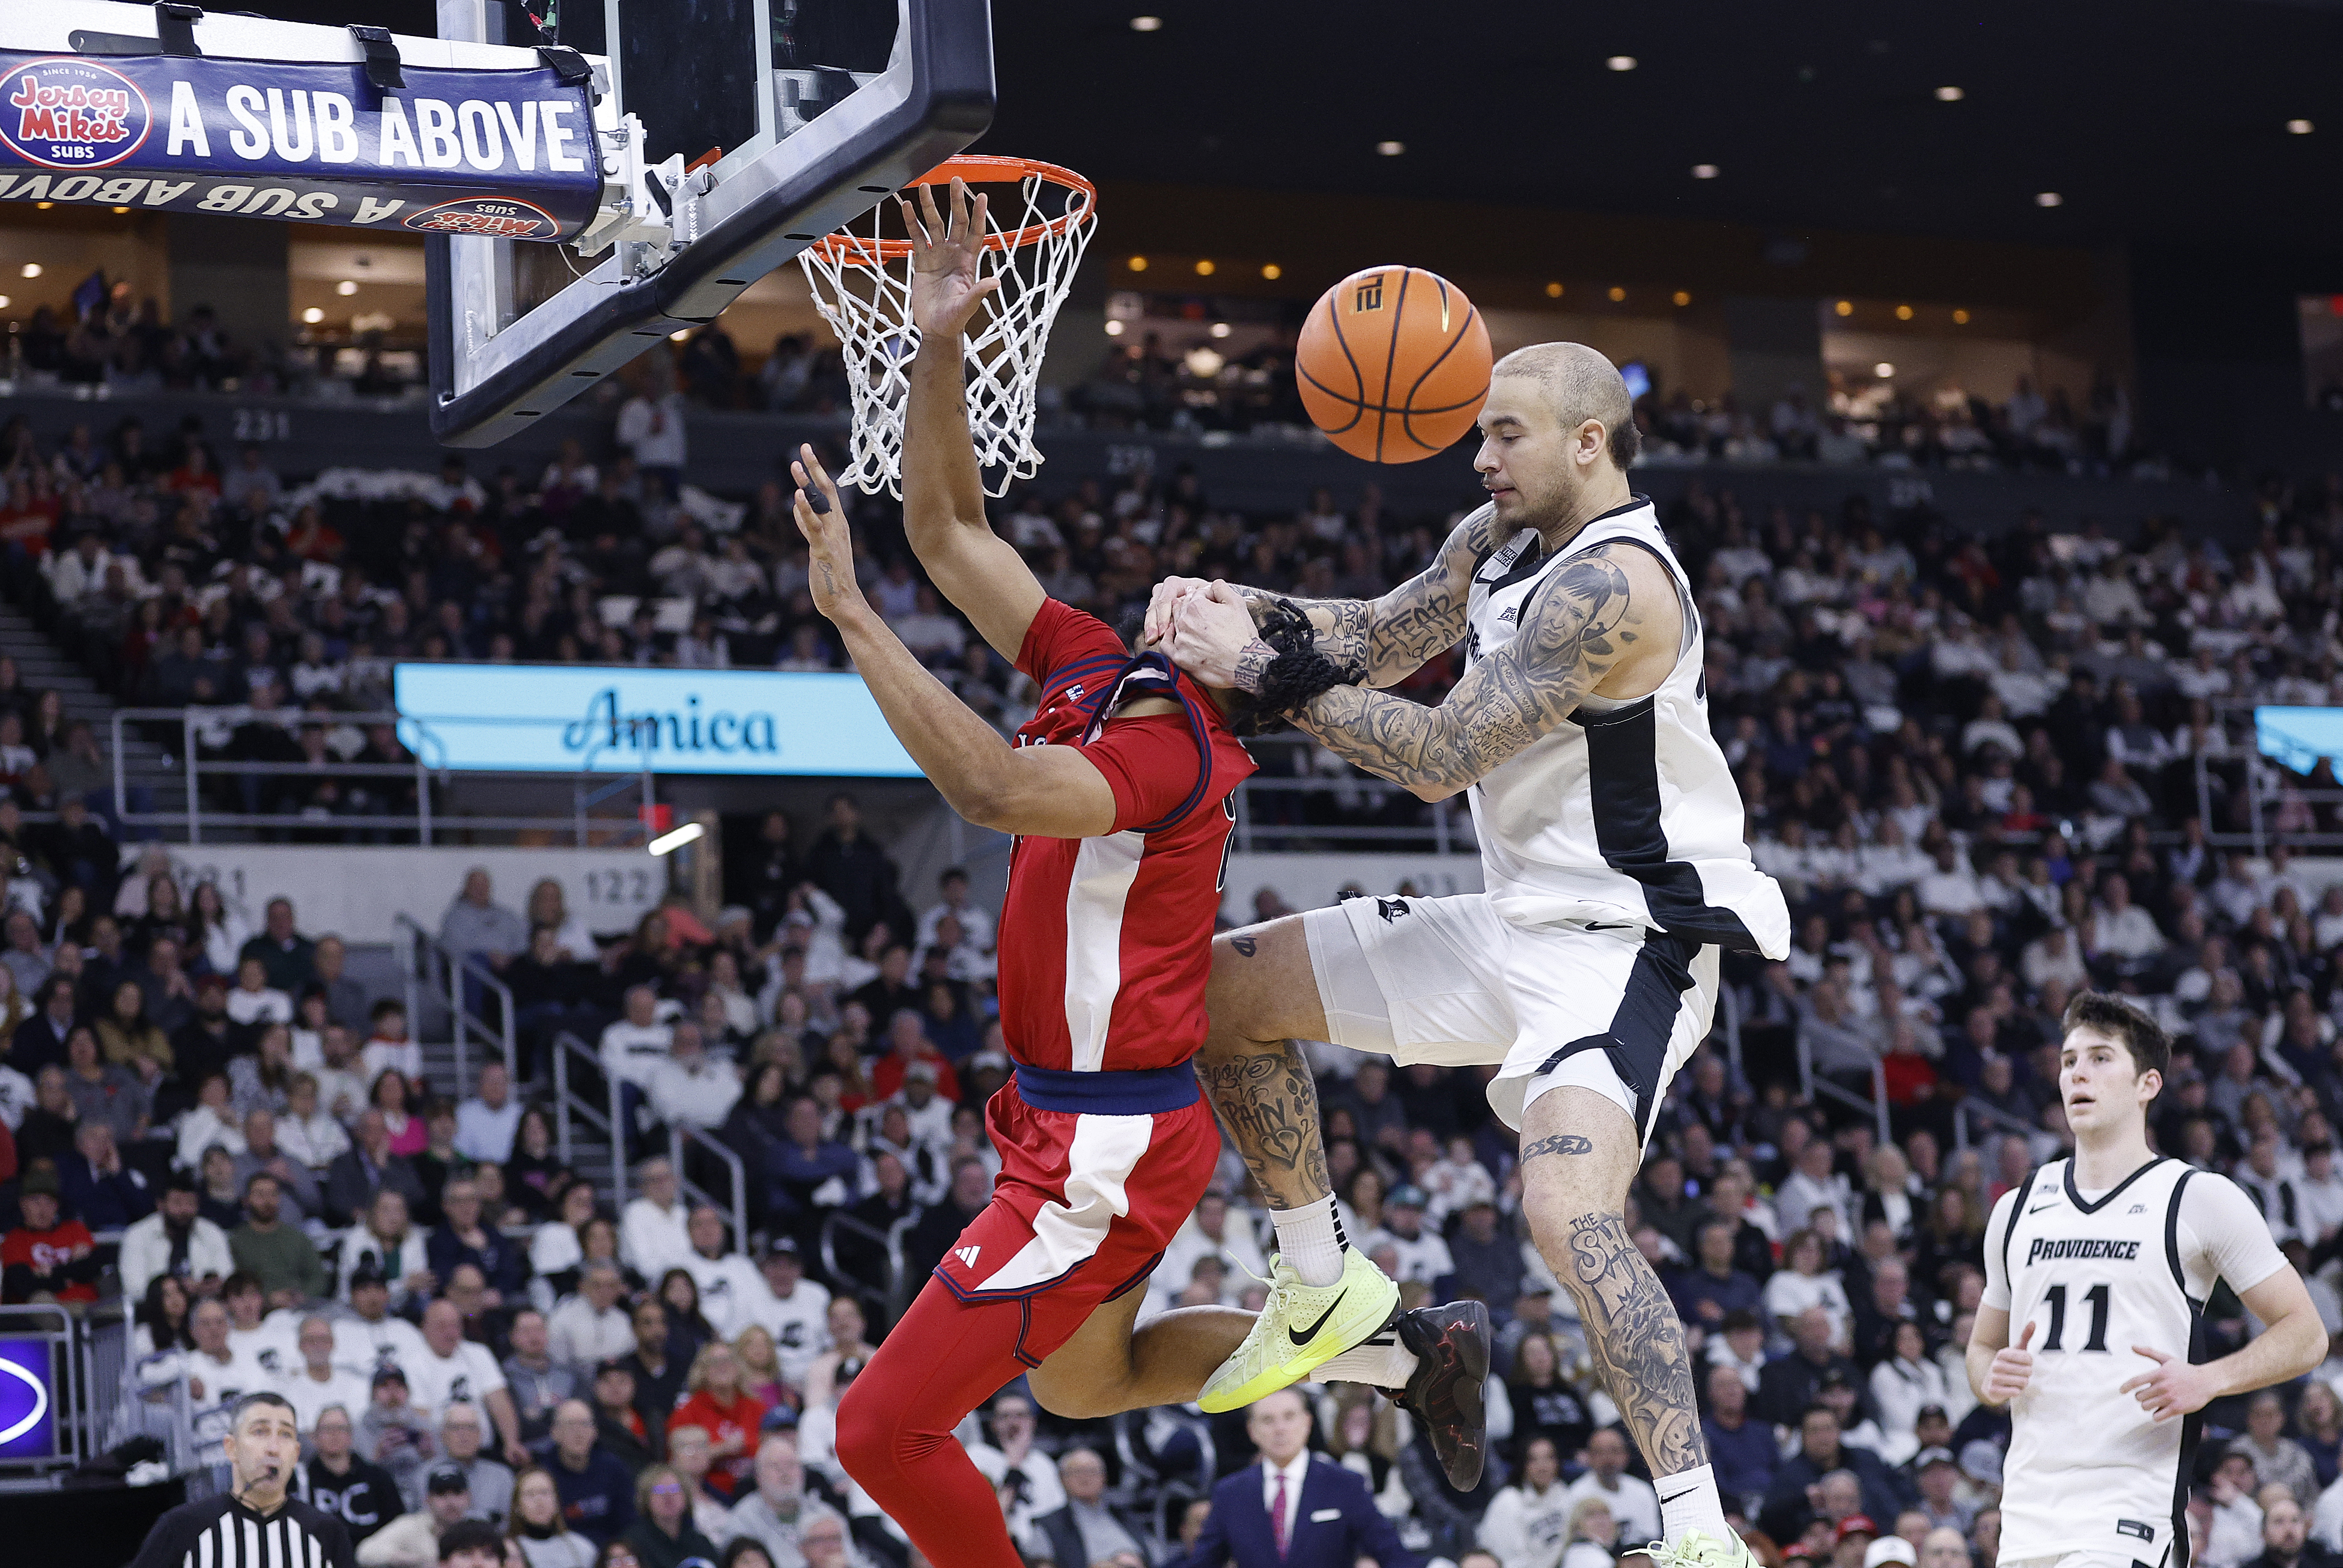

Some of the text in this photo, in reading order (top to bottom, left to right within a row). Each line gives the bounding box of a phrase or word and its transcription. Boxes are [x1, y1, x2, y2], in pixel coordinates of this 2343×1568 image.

[74, 69, 97, 79] 1956
[11, 76, 129, 119] Jersey
[19, 108, 129, 142] Mike's
[166, 81, 585, 172] A SUB ABOVE
[51, 145, 95, 159] SUBS
[196, 184, 339, 219] SUB
[350, 196, 406, 224] A
[475, 204, 518, 216] SUBS
[1498, 656, 1507, 668] THE
[564, 687, 776, 750] Amica
[587, 868, 648, 903] 122
[1569, 1212, 1598, 1232] THE
[2026, 1238, 2142, 1268] PROVIDENCE
[2040, 1283, 2111, 1354] 11
[313, 1481, 379, 1526] PC
